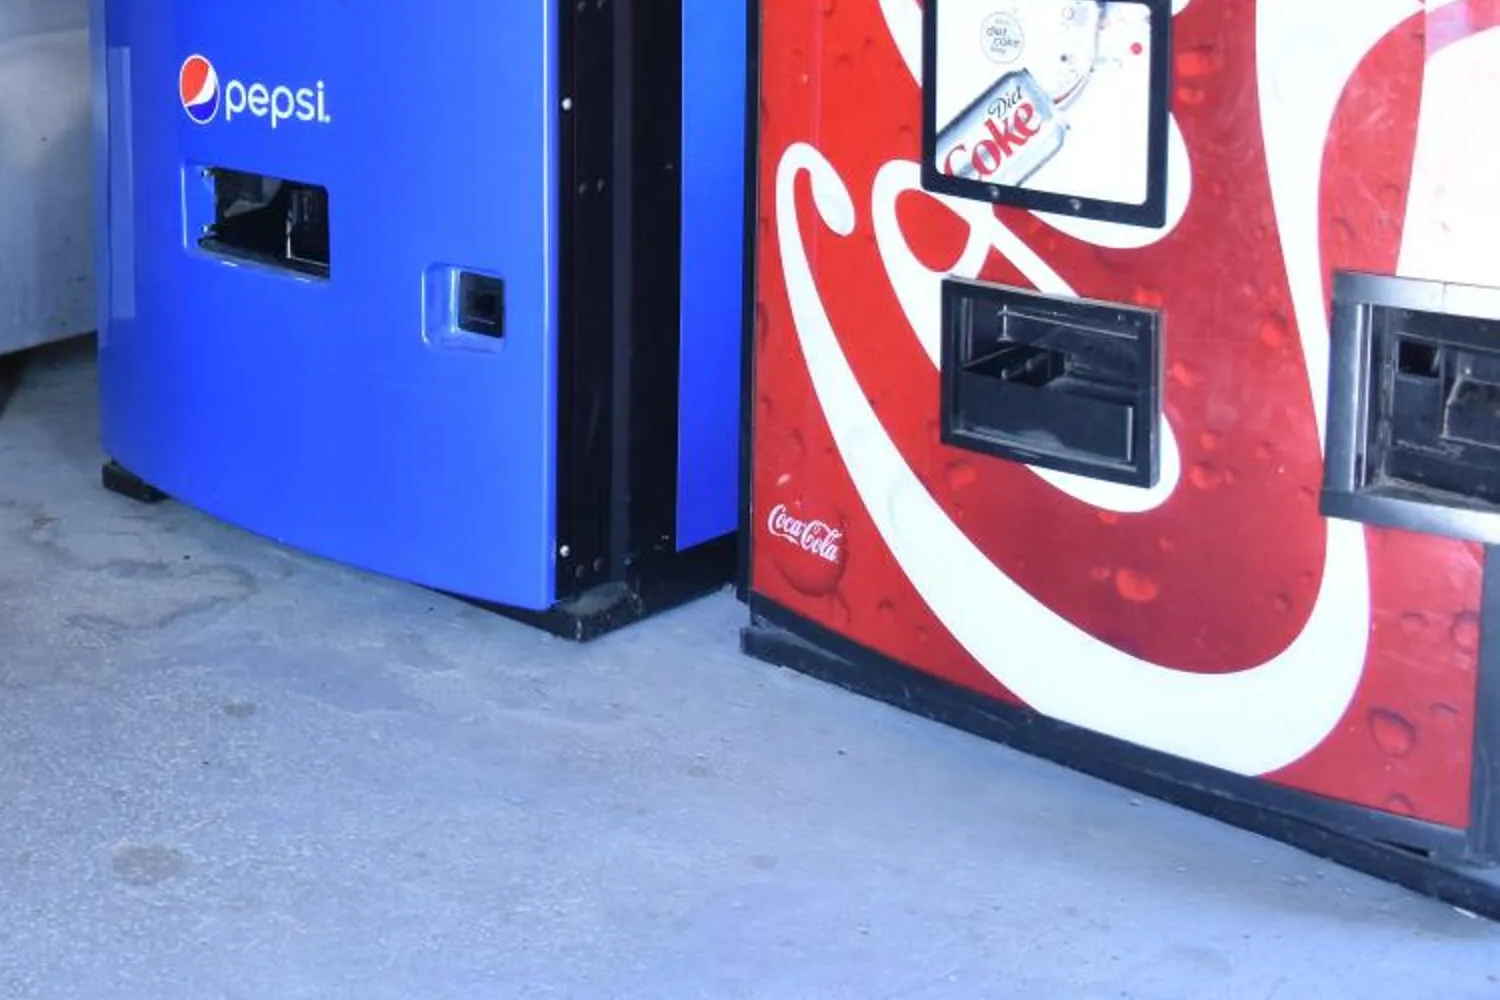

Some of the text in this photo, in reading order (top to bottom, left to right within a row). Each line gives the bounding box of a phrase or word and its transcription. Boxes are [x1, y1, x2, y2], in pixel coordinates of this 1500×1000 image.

[225, 79, 325, 129] pepsi
[987, 85, 1023, 118] Diet
[943, 102, 1042, 178] Coke
